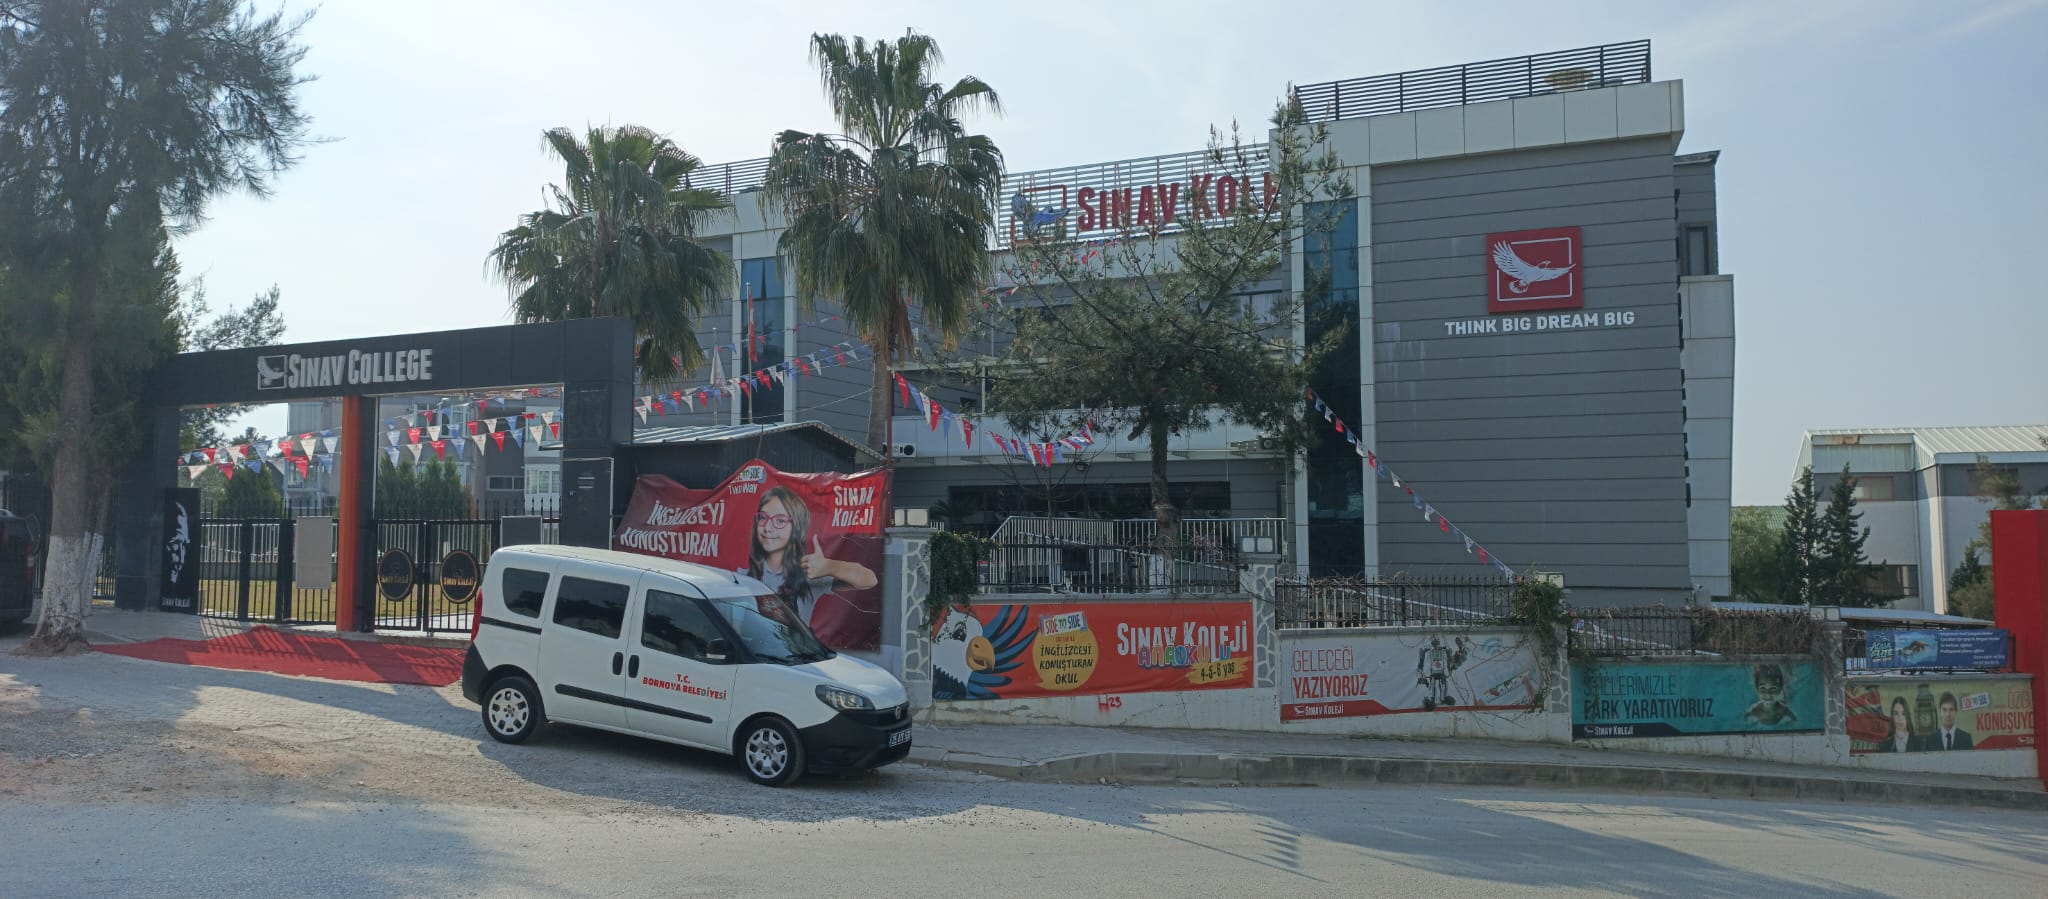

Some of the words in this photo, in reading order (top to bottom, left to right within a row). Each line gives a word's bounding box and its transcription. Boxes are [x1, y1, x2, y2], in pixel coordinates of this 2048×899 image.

[1077, 182, 1180, 231] SINAV
[1445, 320, 1498, 336] THINK
[1502, 316, 1531, 332] BIG
[1536, 313, 1599, 330] DREAM
[1604, 311, 1635, 325] BIG
[288, 352, 346, 389] SINAV
[347, 348, 433, 385] COLLEGE
[833, 485, 875, 506] SINAV
[620, 526, 719, 557] KONUŞTURAN
[1040, 643, 1092, 657] İNGİLİZCEYİ
[1292, 645, 1355, 673] GELECEĞİ
[1040, 658, 1093, 671] KONUŞTURAN
[642, 676, 681, 692] BORNOVA
[682, 685, 727, 700] BELEDİYESİ
[676, 673, 691, 684] T.C.
[1055, 673, 1078, 685] OKUL
[1293, 674, 1368, 699] YAZIYORUZ
[1624, 698, 1714, 719] YARATIYORUZ
